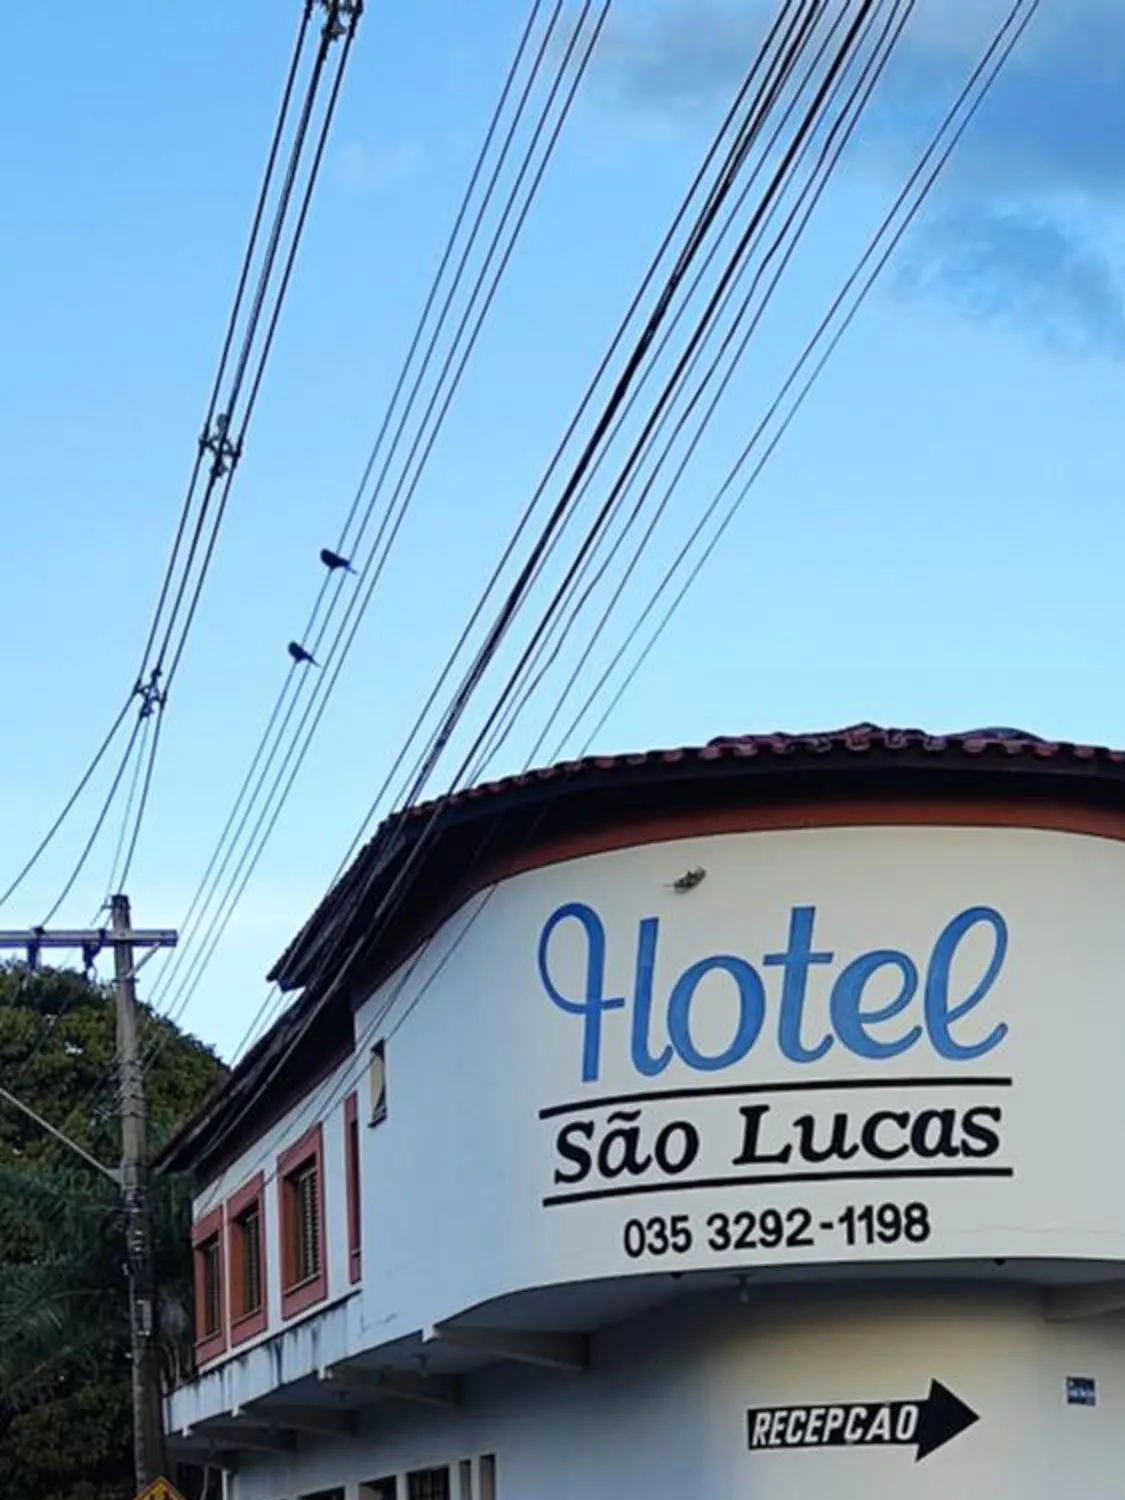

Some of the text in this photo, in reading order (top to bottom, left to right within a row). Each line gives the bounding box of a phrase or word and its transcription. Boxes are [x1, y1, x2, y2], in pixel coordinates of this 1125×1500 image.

[538, 902, 1009, 1083] Hotel
[554, 1104, 1002, 1185] São Lucas
[623, 1202, 931, 1259] 035 3292-1198
